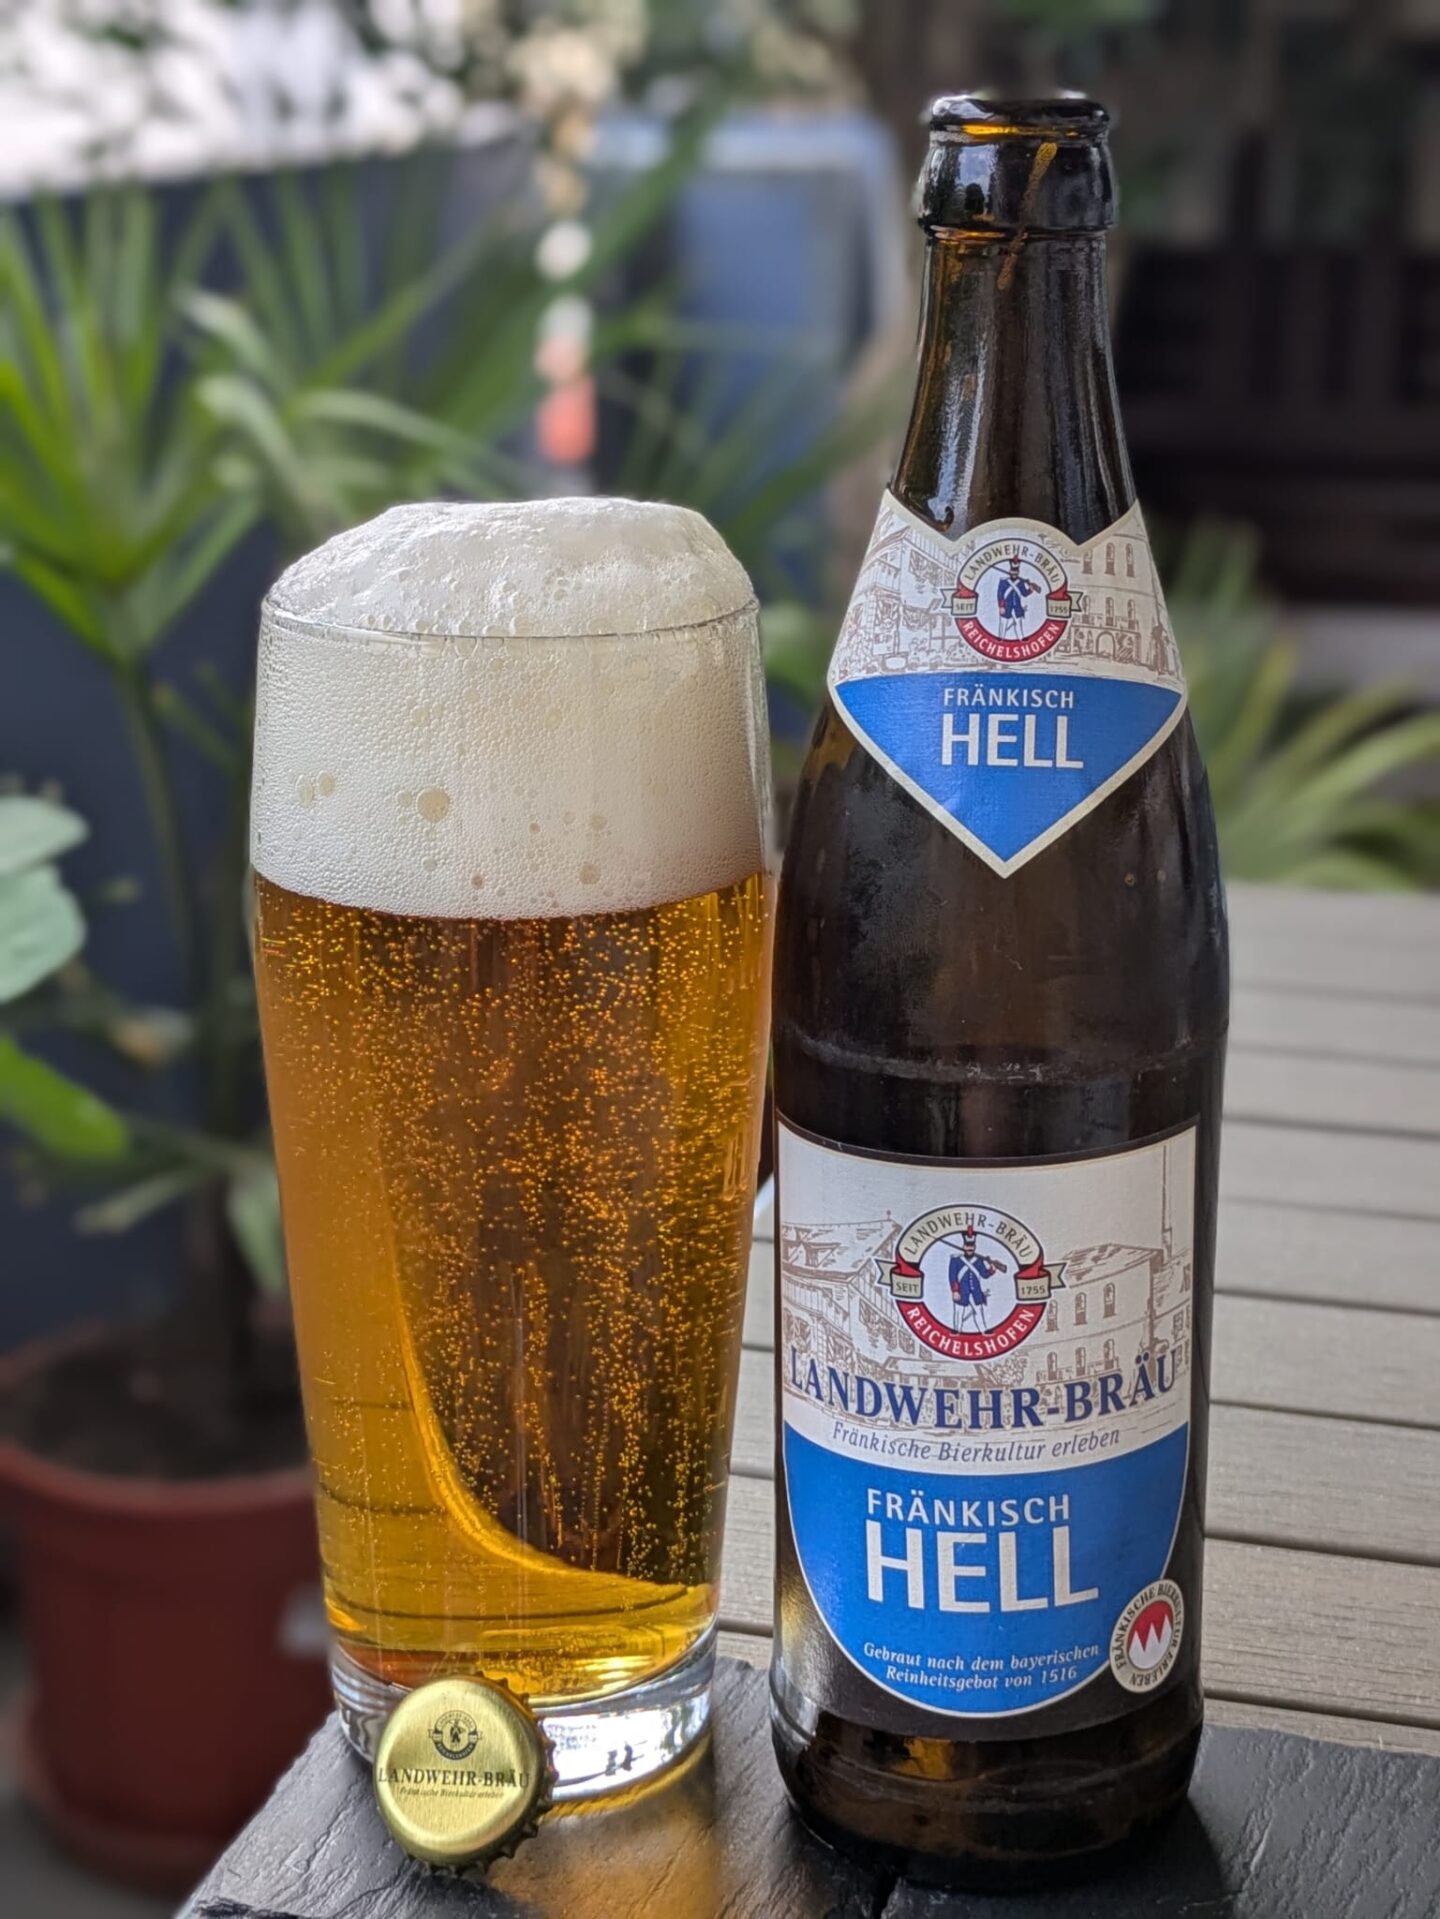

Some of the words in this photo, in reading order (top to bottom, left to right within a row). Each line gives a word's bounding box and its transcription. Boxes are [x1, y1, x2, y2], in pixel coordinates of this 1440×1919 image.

[964, 543, 1061, 584] LANDWEHR-BRÄU
[954, 602, 975, 612] SEIT
[962, 621, 1060, 658] REICHELSHOFEN
[943, 683, 1074, 709] FRÄNKISCH
[941, 713, 1084, 769] HELL
[904, 1211, 1034, 1259] LANDWEHR-BRÄU
[895, 1281, 919, 1294] SEIT
[1020, 1284, 1047, 1296] 1755
[906, 1306, 1035, 1357] REICHELSHOFEN
[790, 1345, 1177, 1430] LANDWEHR-BRÄU
[832, 1420, 931, 1460] Fränkische
[938, 1441, 1046, 1463] Bierkultur
[1052, 1428, 1120, 1457] erleben
[867, 1488, 1070, 1527] FRÄNKISCH
[865, 1520, 1100, 1614] HELL
[1112, 1586, 1156, 1670] FRÄNKISCHE
[863, 1642, 922, 1667] Gebraut
[927, 1656, 965, 1672] nach
[971, 1655, 1005, 1671] dem
[1010, 1643, 1100, 1671] bayerischen
[886, 1664, 999, 1691] Reinheitsgebot
[1004, 1673, 1033, 1688] von
[1041, 1666, 1077, 1685] 1516
[378, 1767, 531, 1789] LANDWEHR-BRÄU
